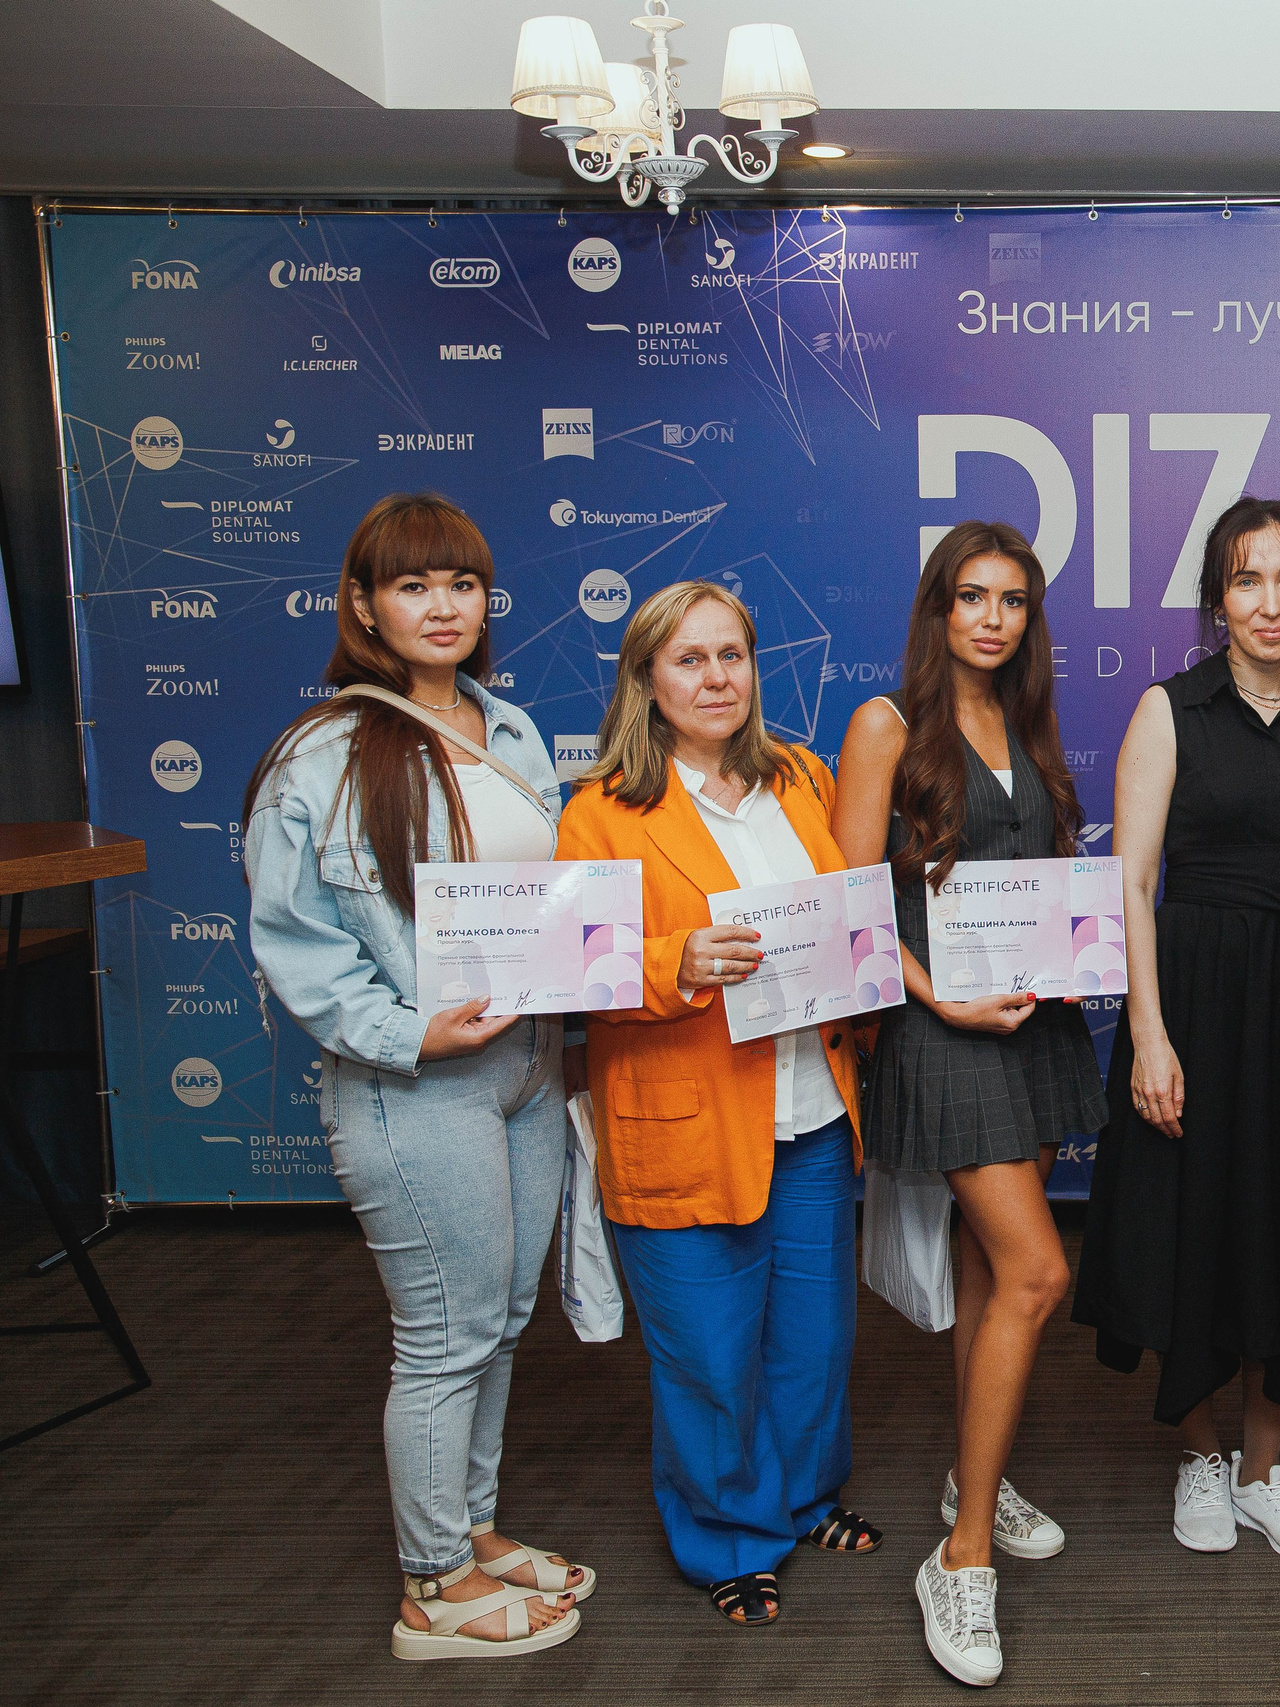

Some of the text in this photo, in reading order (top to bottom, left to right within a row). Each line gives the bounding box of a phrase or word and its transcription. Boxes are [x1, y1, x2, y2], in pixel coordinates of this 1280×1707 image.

[991, 248, 1039, 260] ZEISS
[573, 256, 617, 270] KAPS
[838, 253, 919, 270] ЭКРАДЕНТ
[300, 262, 361, 282] inibsa
[435, 262, 495, 281] ekom
[132, 271, 198, 289] FONA
[691, 275, 751, 287] SANOFI
[958, 290, 1150, 334] Знания
[637, 323, 722, 334] DIPLOMAT
[125, 338, 166, 346] PHILIPS
[638, 339, 700, 350] DENTAL
[837, 332, 893, 352] VDW
[440, 345, 501, 360] MELAG
[126, 352, 200, 370] ZOOM!
[284, 360, 357, 371] I.C.LERCHER
[638, 354, 728, 365] SOLUTIONS
[545, 423, 591, 434] ZEISS
[136, 436, 180, 449] KAPS
[396, 434, 475, 451] ЭКРАДЕНТ
[253, 454, 311, 467] SANOFI
[211, 501, 293, 512] DIPLOMAT
[212, 517, 272, 528] DENTAL
[581, 507, 711, 527] Tokuyama Dental
[212, 531, 300, 543] SOLUTIONS
[584, 588, 627, 602] KAPS
[151, 601, 217, 618] FONA
[146, 664, 185, 672] PHILIPS
[841, 663, 898, 682] VDW
[146, 678, 219, 696] ZOOM!
[156, 759, 198, 772] KAPS
[1074, 861, 1117, 872] DIZANE
[848, 871, 885, 887] DIZANE
[435, 884, 548, 898] CERTIFICATE
[943, 880, 1040, 894] CERTIFICATE
[733, 899, 821, 926] CERTIFICATE
[945, 919, 1037, 929] СТЕФАШИНА Алина
[171, 923, 235, 941] FONA
[436, 927, 540, 937] ЯКУЧАКОВА Олеся
[792, 941, 816, 951] Елена
[166, 984, 205, 993] PHILIPS
[167, 998, 238, 1015] ZOOM!
[176, 1076, 218, 1088] KAPS
[251, 1136, 329, 1147] DIPLOMAT
[251, 1151, 310, 1161] DENTAL
[252, 1164, 336, 1175] SOLUTIONS
